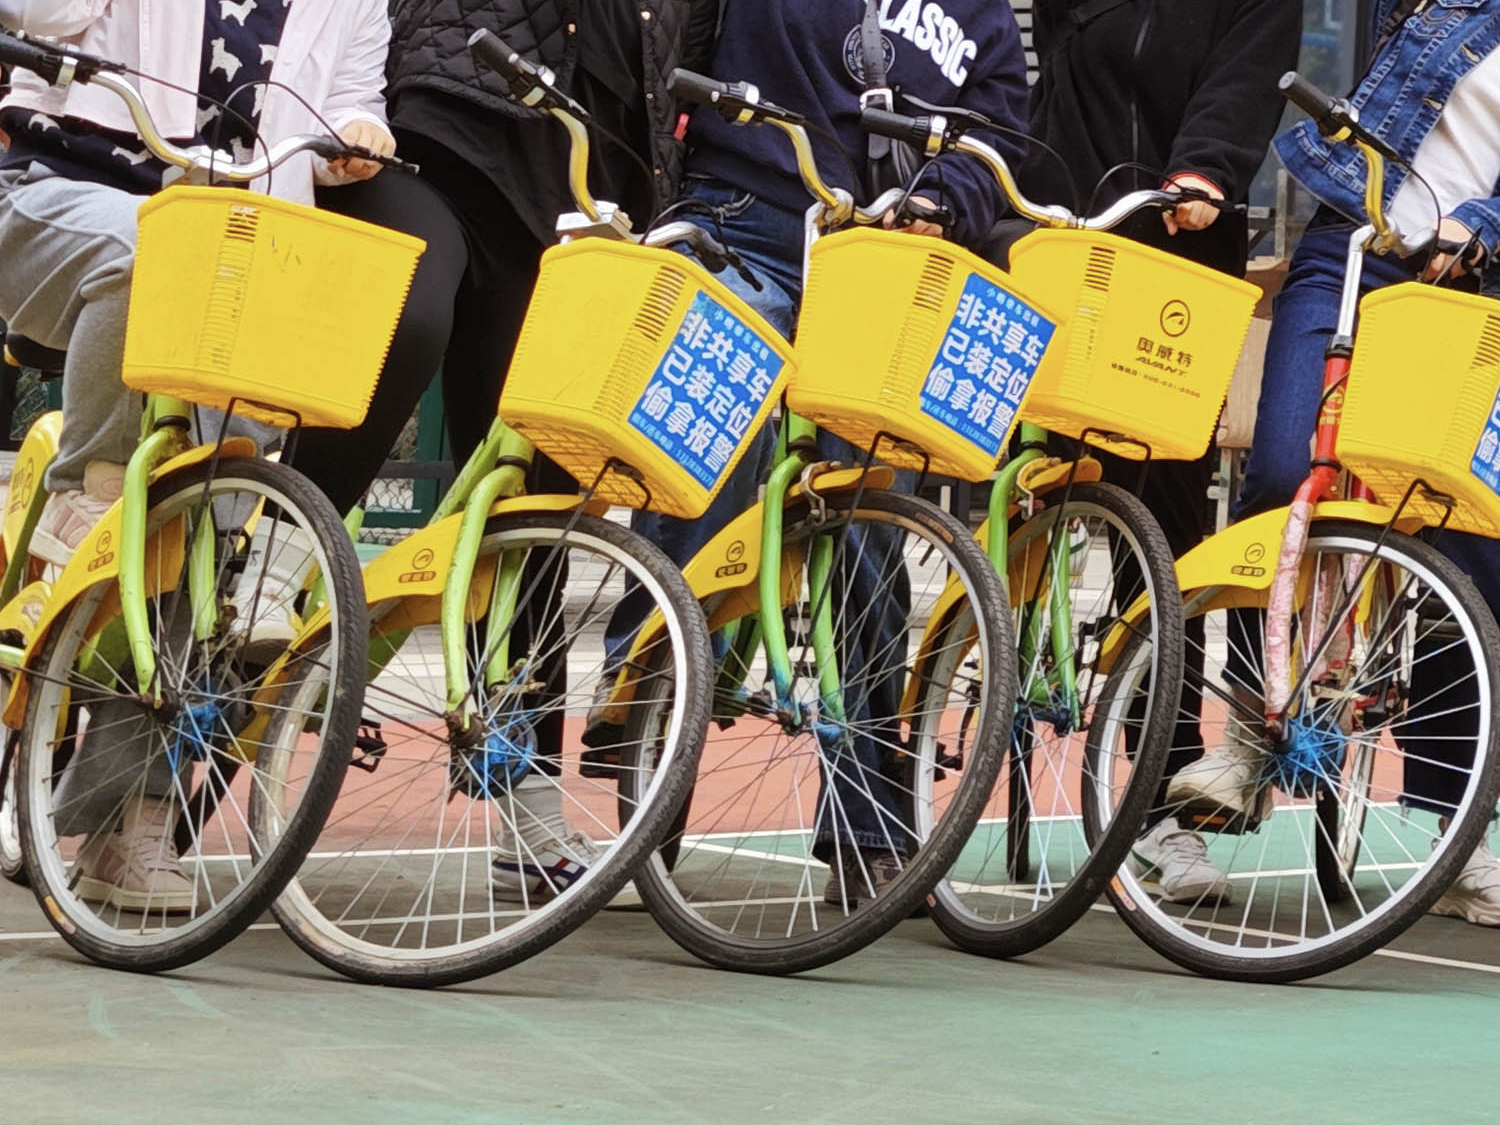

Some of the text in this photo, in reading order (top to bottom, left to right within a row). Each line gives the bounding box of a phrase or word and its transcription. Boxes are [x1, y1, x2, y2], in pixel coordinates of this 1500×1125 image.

[678, 312, 772, 404] 非共享车
[941, 328, 1031, 405] 已装定位
[954, 292, 1046, 369] 非共享车
[640, 380, 737, 473] 偷拿报警
[662, 345, 754, 441] 已装定位
[925, 362, 1016, 440] 偷拿报警
